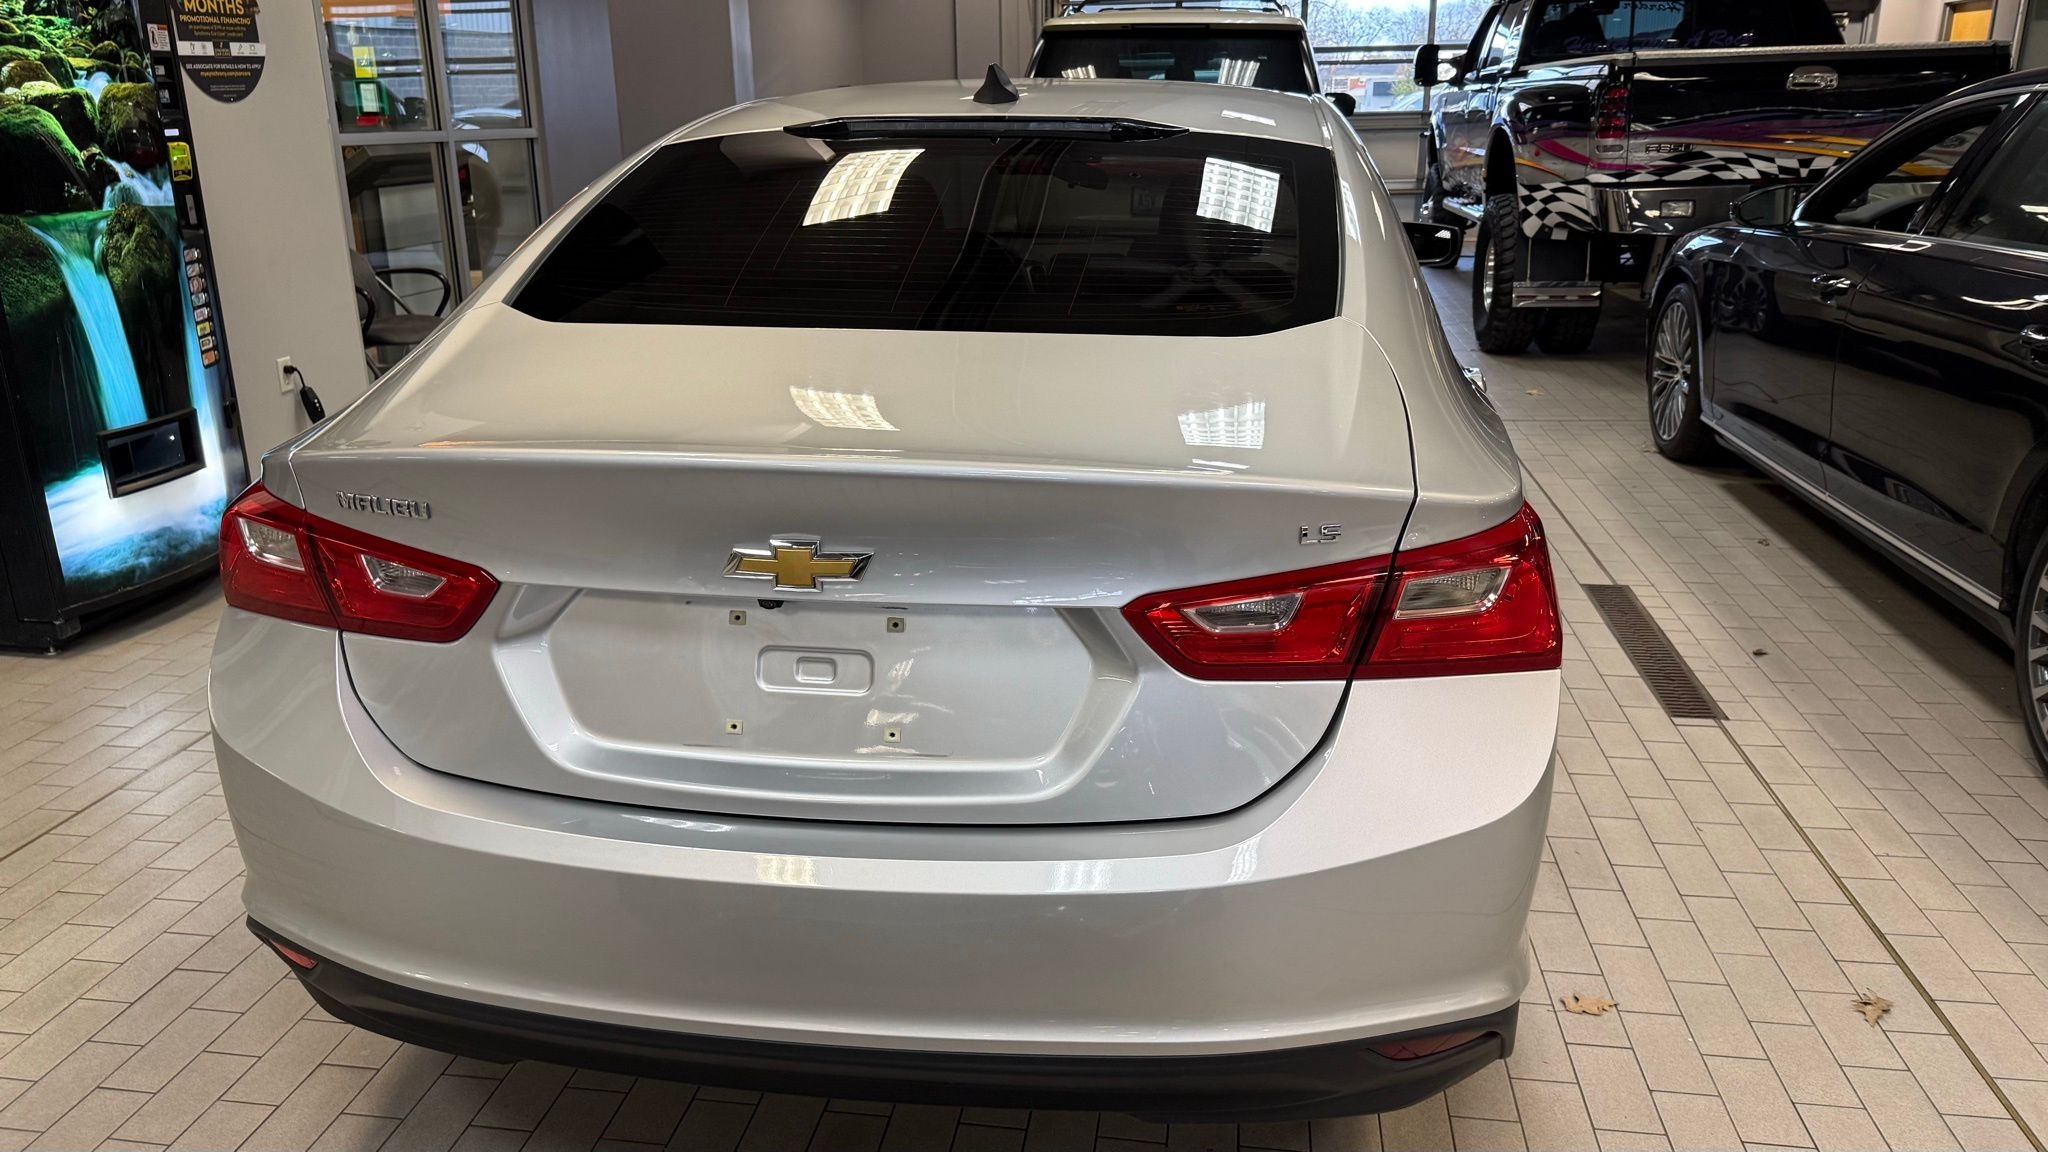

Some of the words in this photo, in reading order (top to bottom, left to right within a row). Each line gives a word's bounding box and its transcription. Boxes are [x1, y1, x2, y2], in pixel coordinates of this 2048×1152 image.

[184, 0, 244, 15] MONTHS
[179, 15, 220, 24] PROMOTIONAL
[336, 491, 432, 520] MALIBU
[1299, 523, 1341, 544] LS
